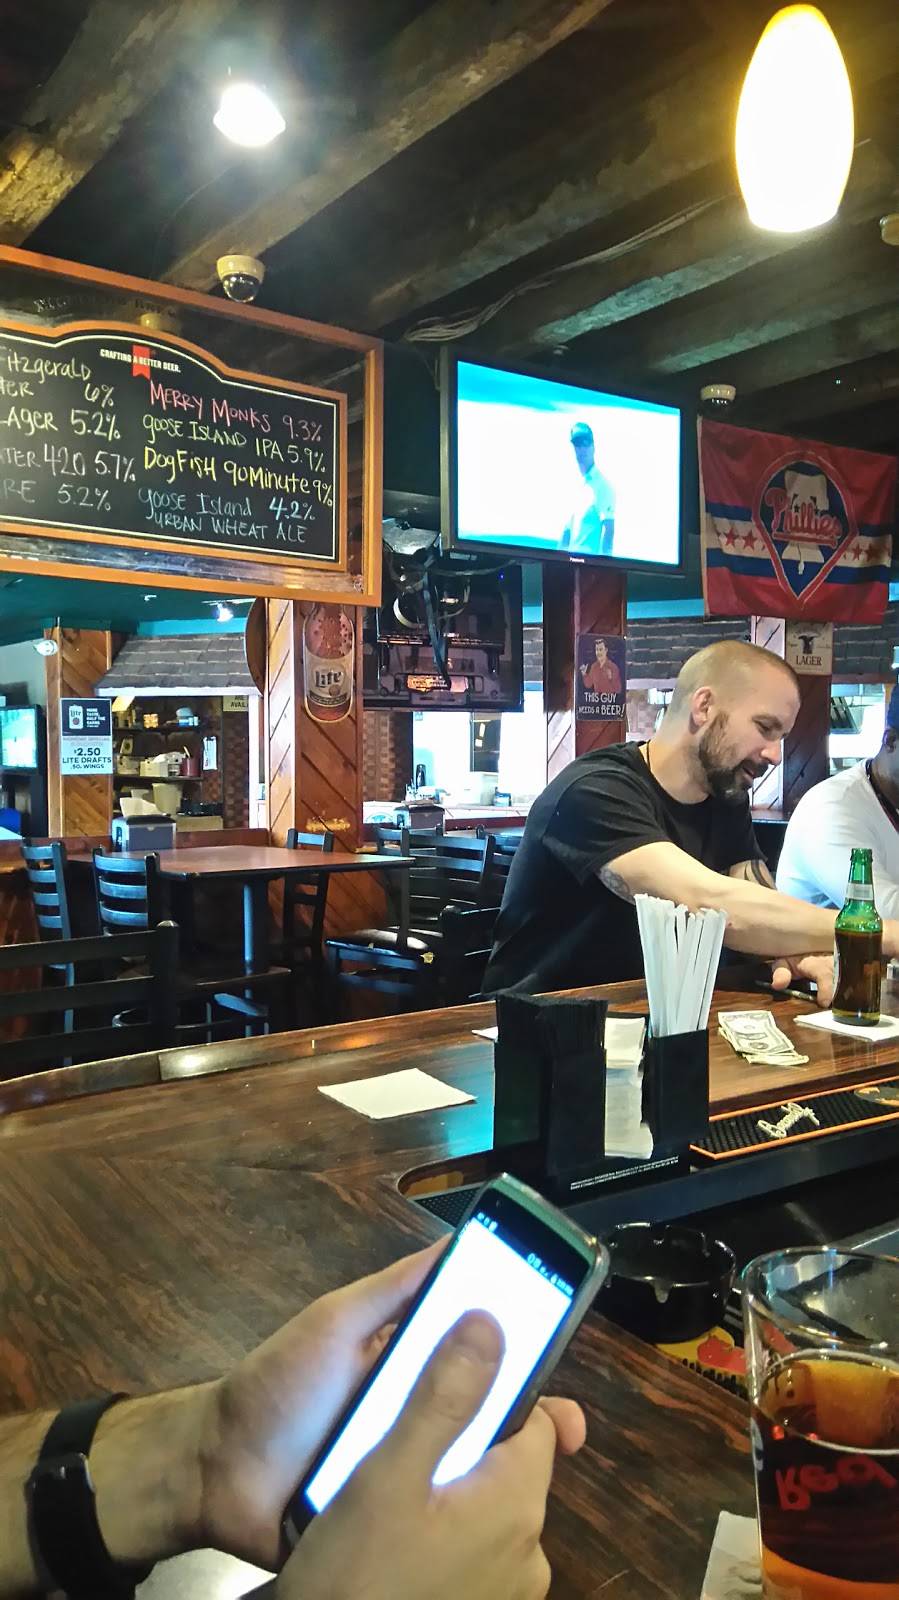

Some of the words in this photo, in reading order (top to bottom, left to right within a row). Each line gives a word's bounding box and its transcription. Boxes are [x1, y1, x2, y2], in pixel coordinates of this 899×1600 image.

[100, 348, 132, 363] CRAFTING
[132, 355, 138, 364] A
[139, 356, 162, 369] BETTER
[84, 383, 115, 408] 6%
[150, 380, 203, 420] MERRY
[212, 398, 271, 433] MONKS
[282, 414, 322, 442] 9.3%
[71, 409, 121, 441] 5.2%
[187, 421, 247, 447] ISLAND
[255, 437, 284, 462] IPA
[287, 444, 326, 472] 5.9%
[44, 443, 86, 476] 420
[94, 450, 136, 482] 5.7%
[58, 484, 111, 511] 5.2%
[196, 492, 252, 517] Island
[269, 497, 316, 520] 4.2%
[312, 479, 333, 507] 9%
[764, 487, 842, 539] Phillies
[154, 511, 202, 532] URBAN
[211, 516, 268, 540] WHEAT
[277, 521, 307, 543] ALE
[796, 655, 822, 666] LAGER
[315, 671, 342, 688] Lite
[578, 706, 595, 714] NEEDS
[596, 706, 600, 714] A
[601, 704, 625, 717] BEER!
[584, 692, 600, 703] THIS
[600, 692, 617, 703] GUY
[74, 747, 101, 757] $2.50
